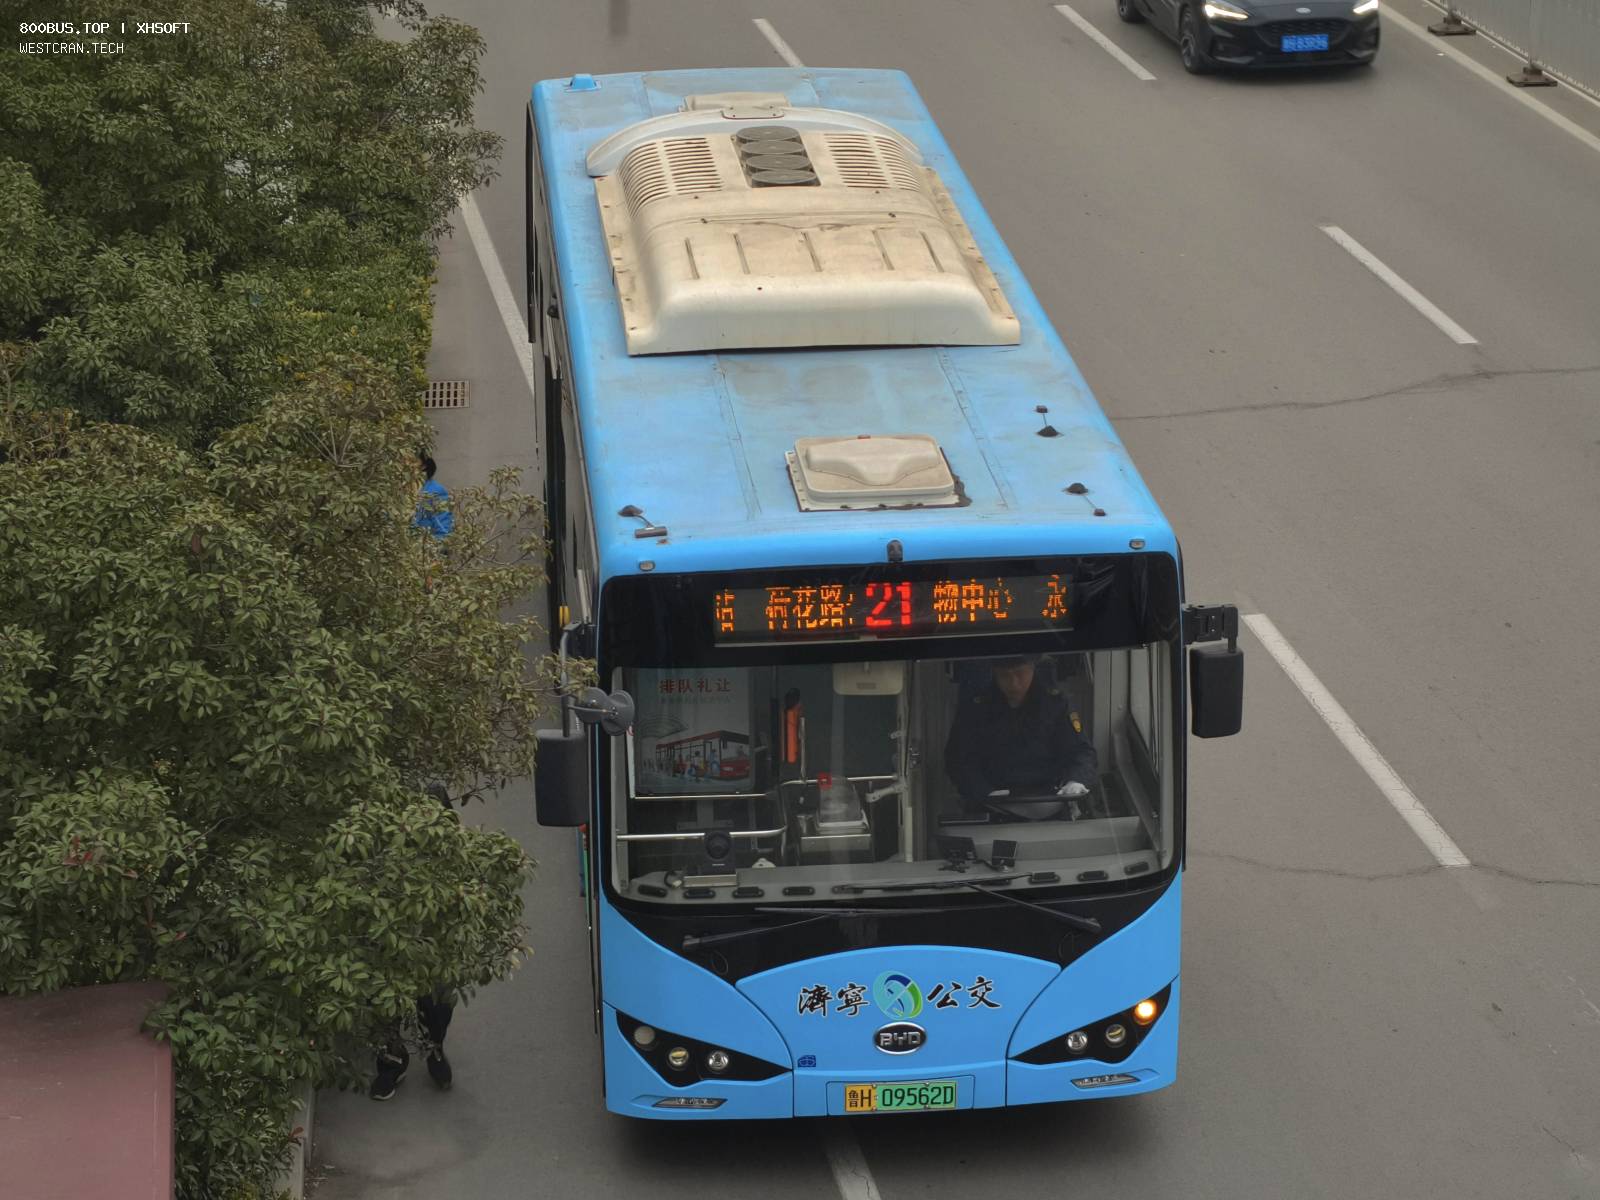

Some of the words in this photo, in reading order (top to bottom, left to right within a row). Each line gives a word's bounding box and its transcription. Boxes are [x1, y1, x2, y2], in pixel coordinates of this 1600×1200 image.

[764, 584, 855, 631] 荷花路
[865, 581, 913, 627] 21
[659, 678, 731, 694] 排队礼让
[926, 975, 1002, 1009] 公交
[879, 1031, 921, 1047] BYD
